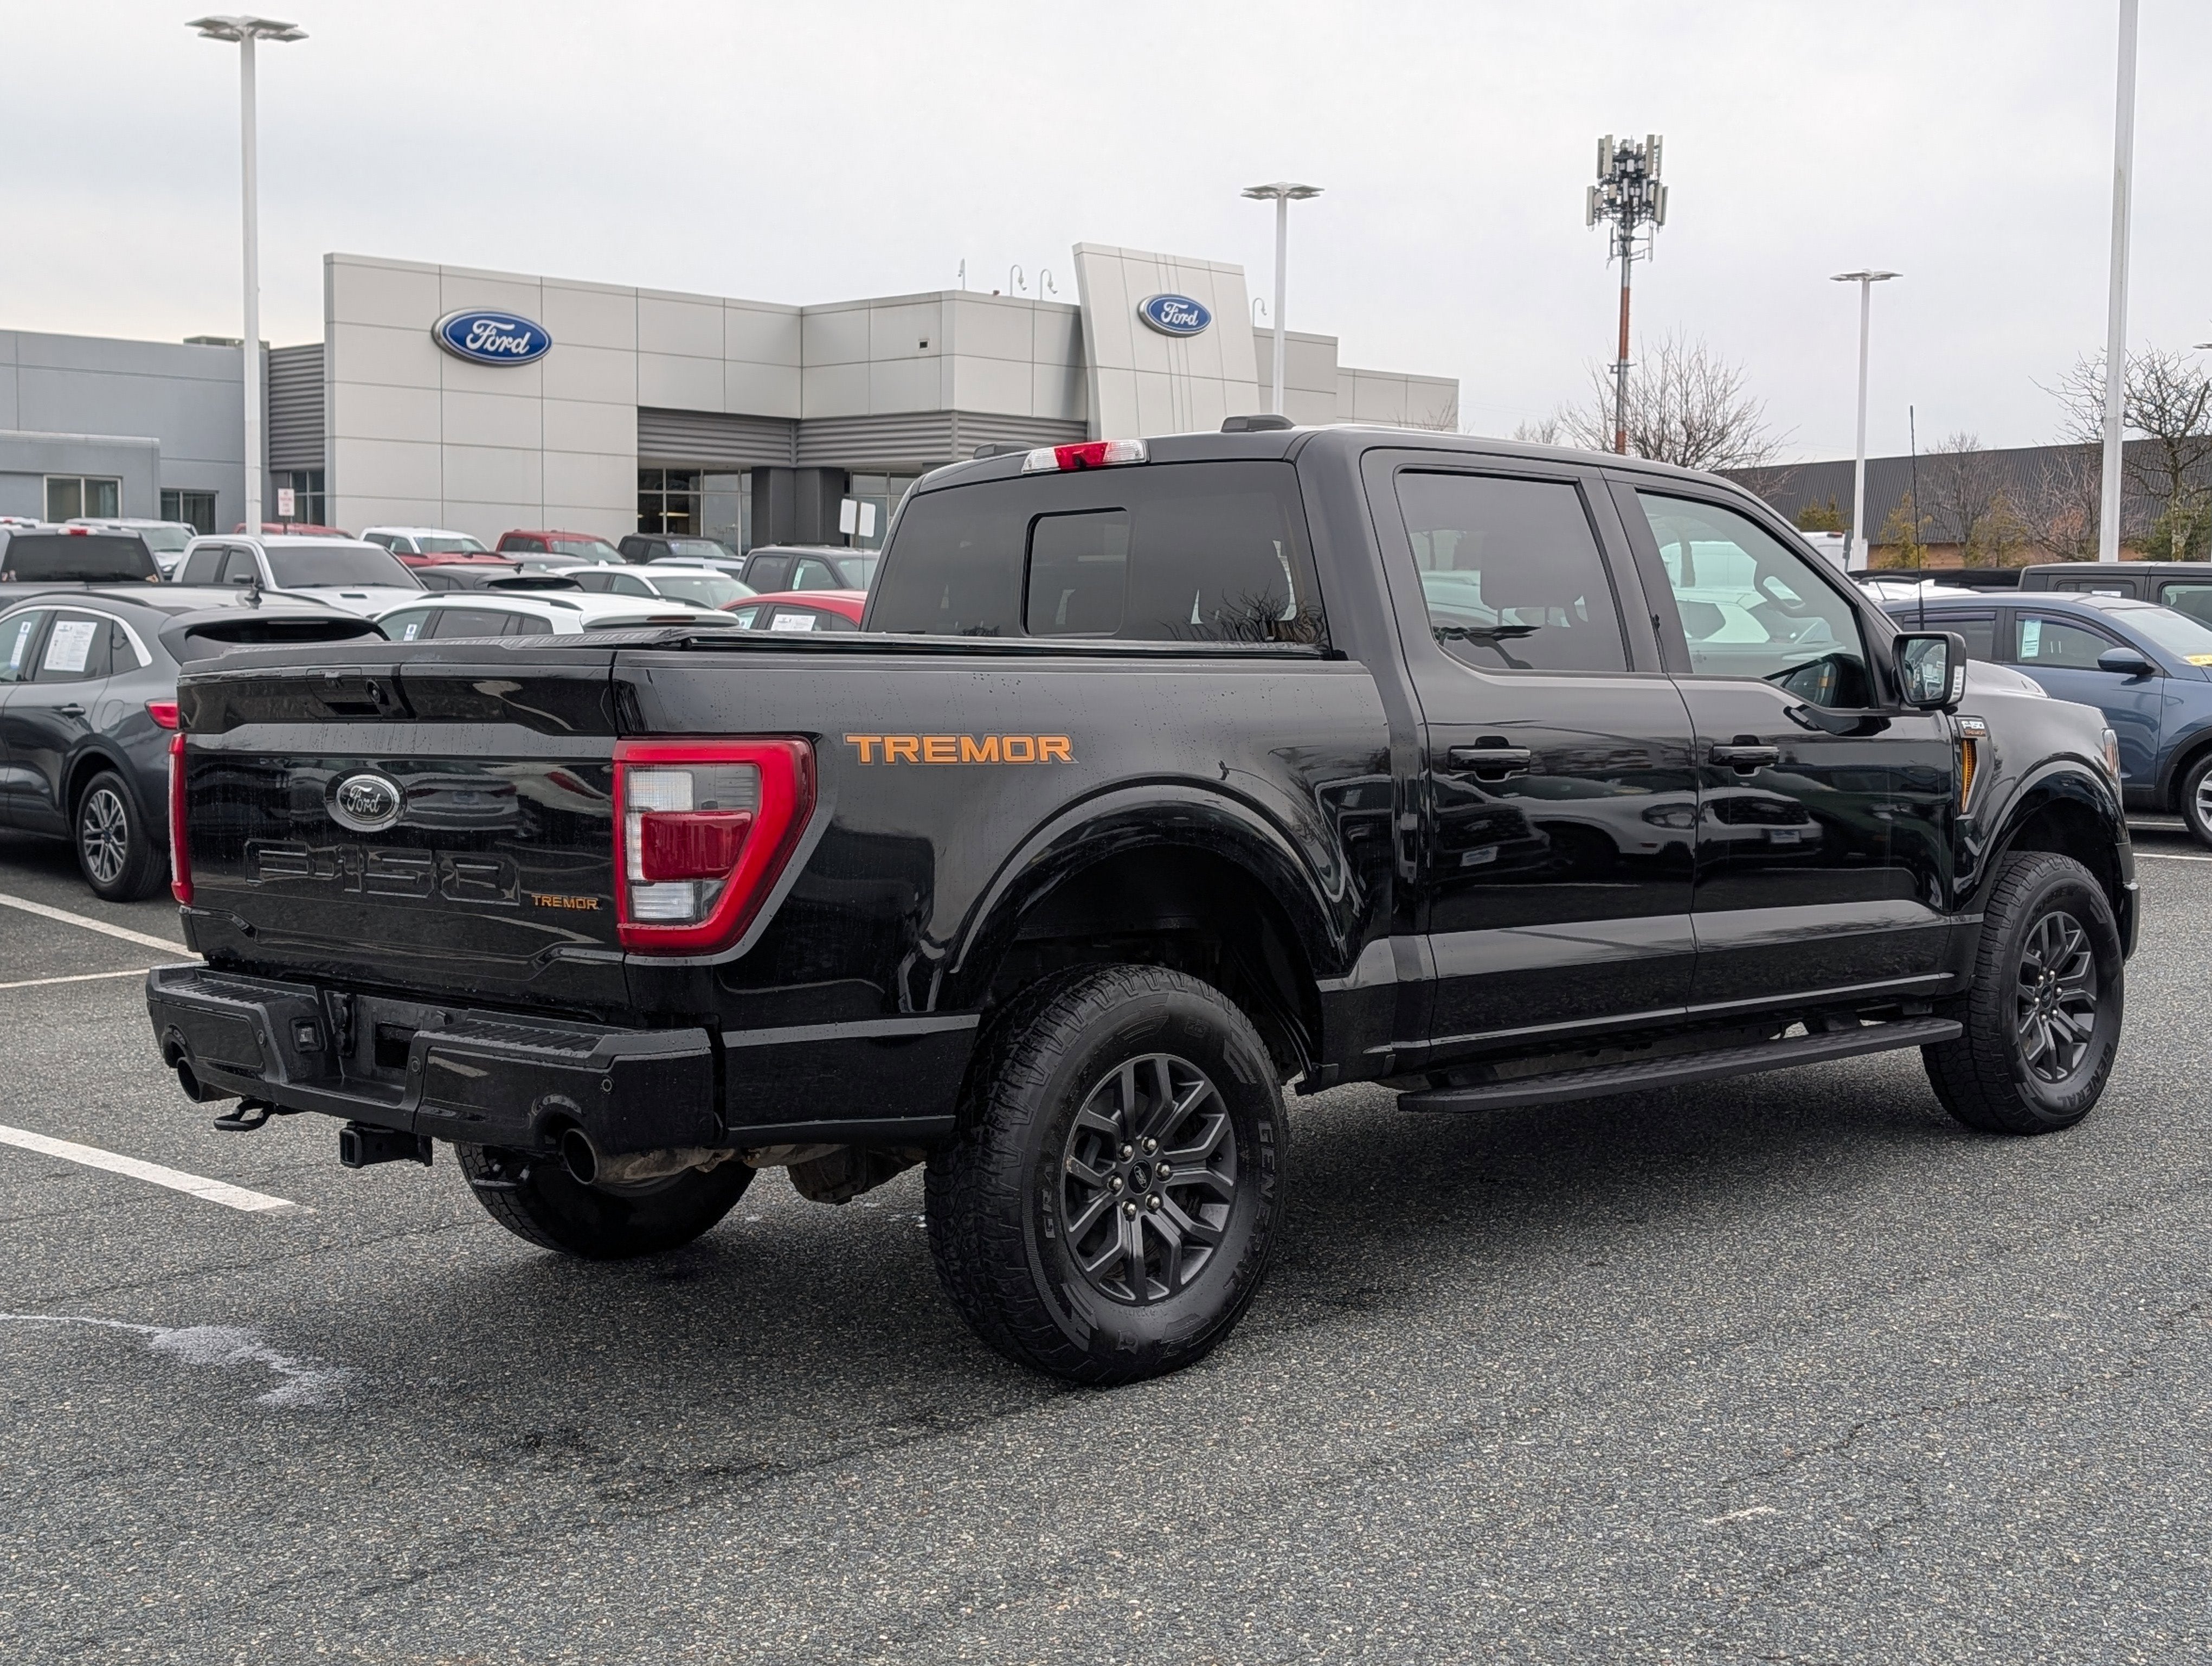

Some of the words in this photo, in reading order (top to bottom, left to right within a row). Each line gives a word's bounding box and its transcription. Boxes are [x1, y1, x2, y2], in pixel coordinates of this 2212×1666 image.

[1160, 302, 1199, 326] Ford
[466, 319, 531, 354] Ford
[844, 733, 1078, 764] TREMOR
[347, 785, 381, 813] Ford
[531, 893, 602, 910] TREMOR
[2057, 1042, 2112, 1107] GENERAL
